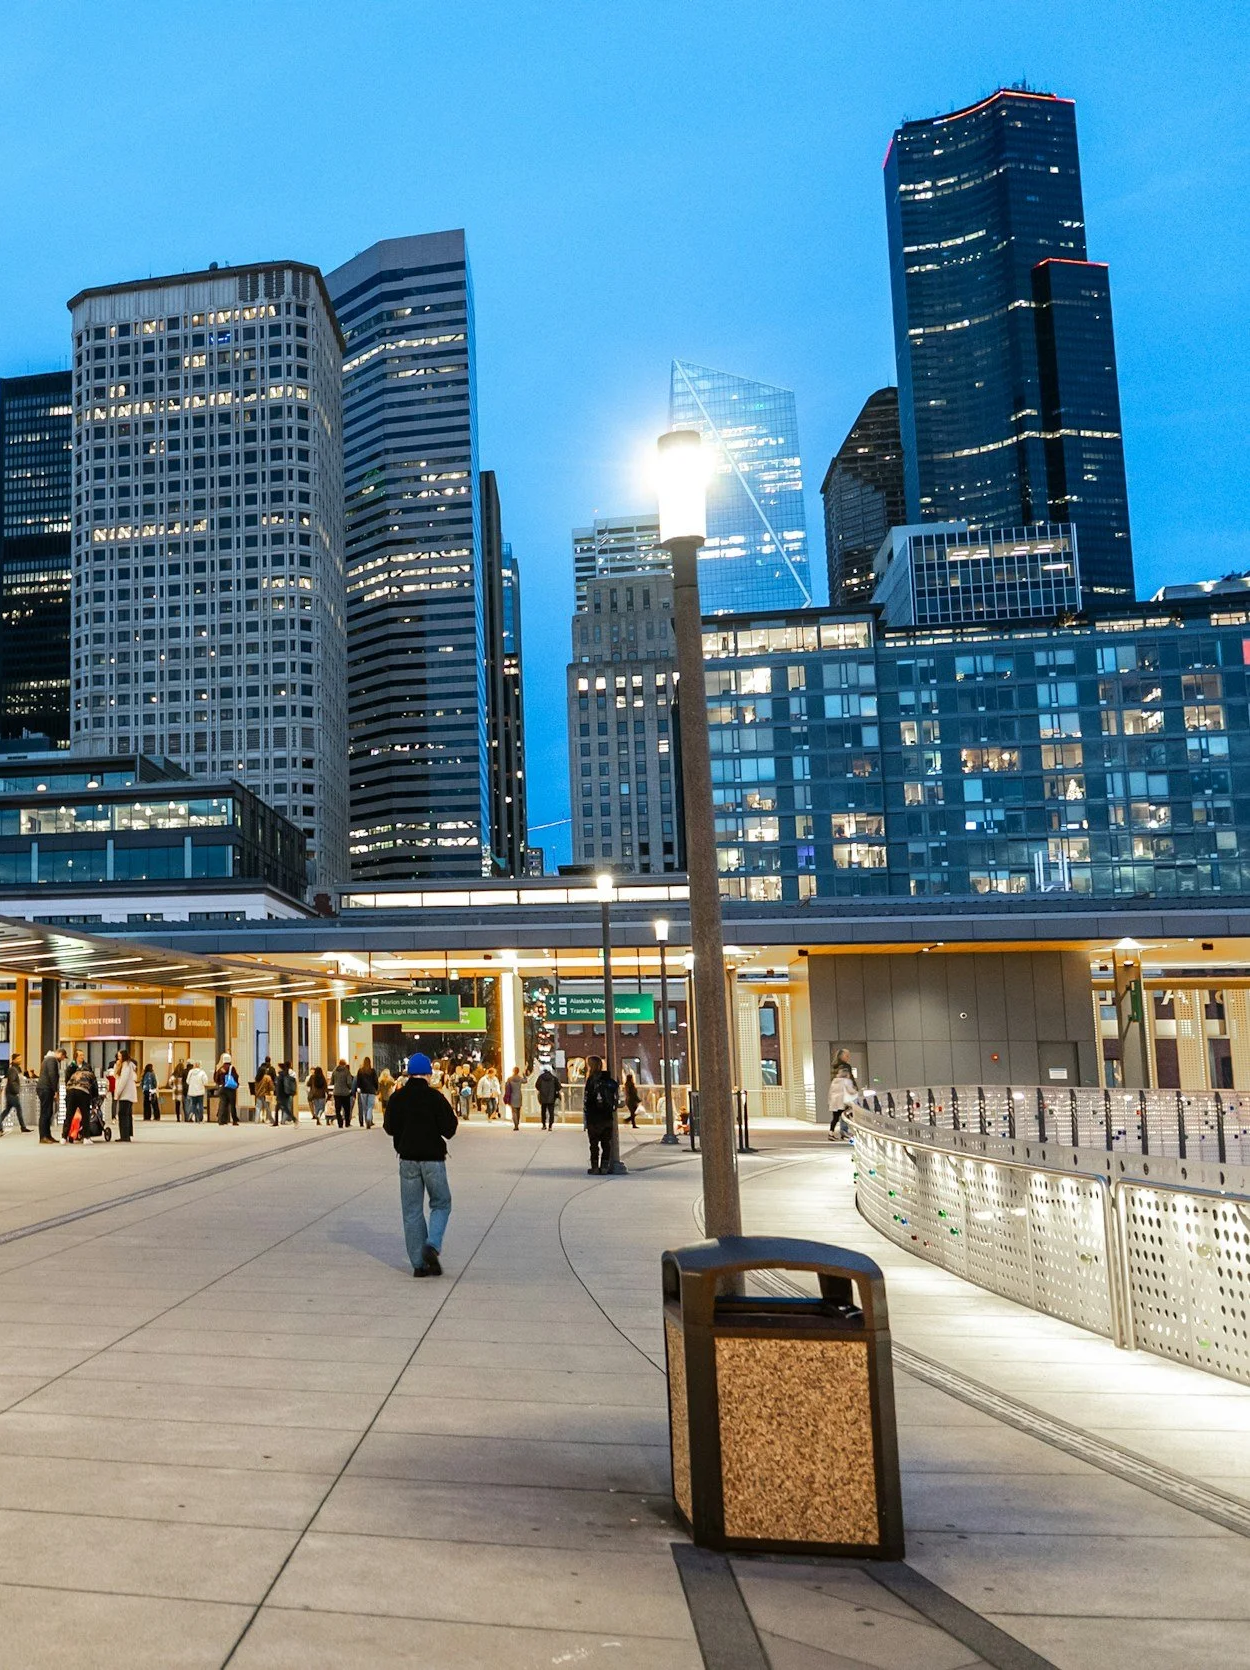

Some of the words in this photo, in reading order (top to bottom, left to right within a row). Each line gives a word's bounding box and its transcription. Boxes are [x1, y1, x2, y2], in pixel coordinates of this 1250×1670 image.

[393, 1008, 406, 1016] Light
[102, 1017, 122, 1025] FERRIES
[178, 1018, 212, 1027] Information
